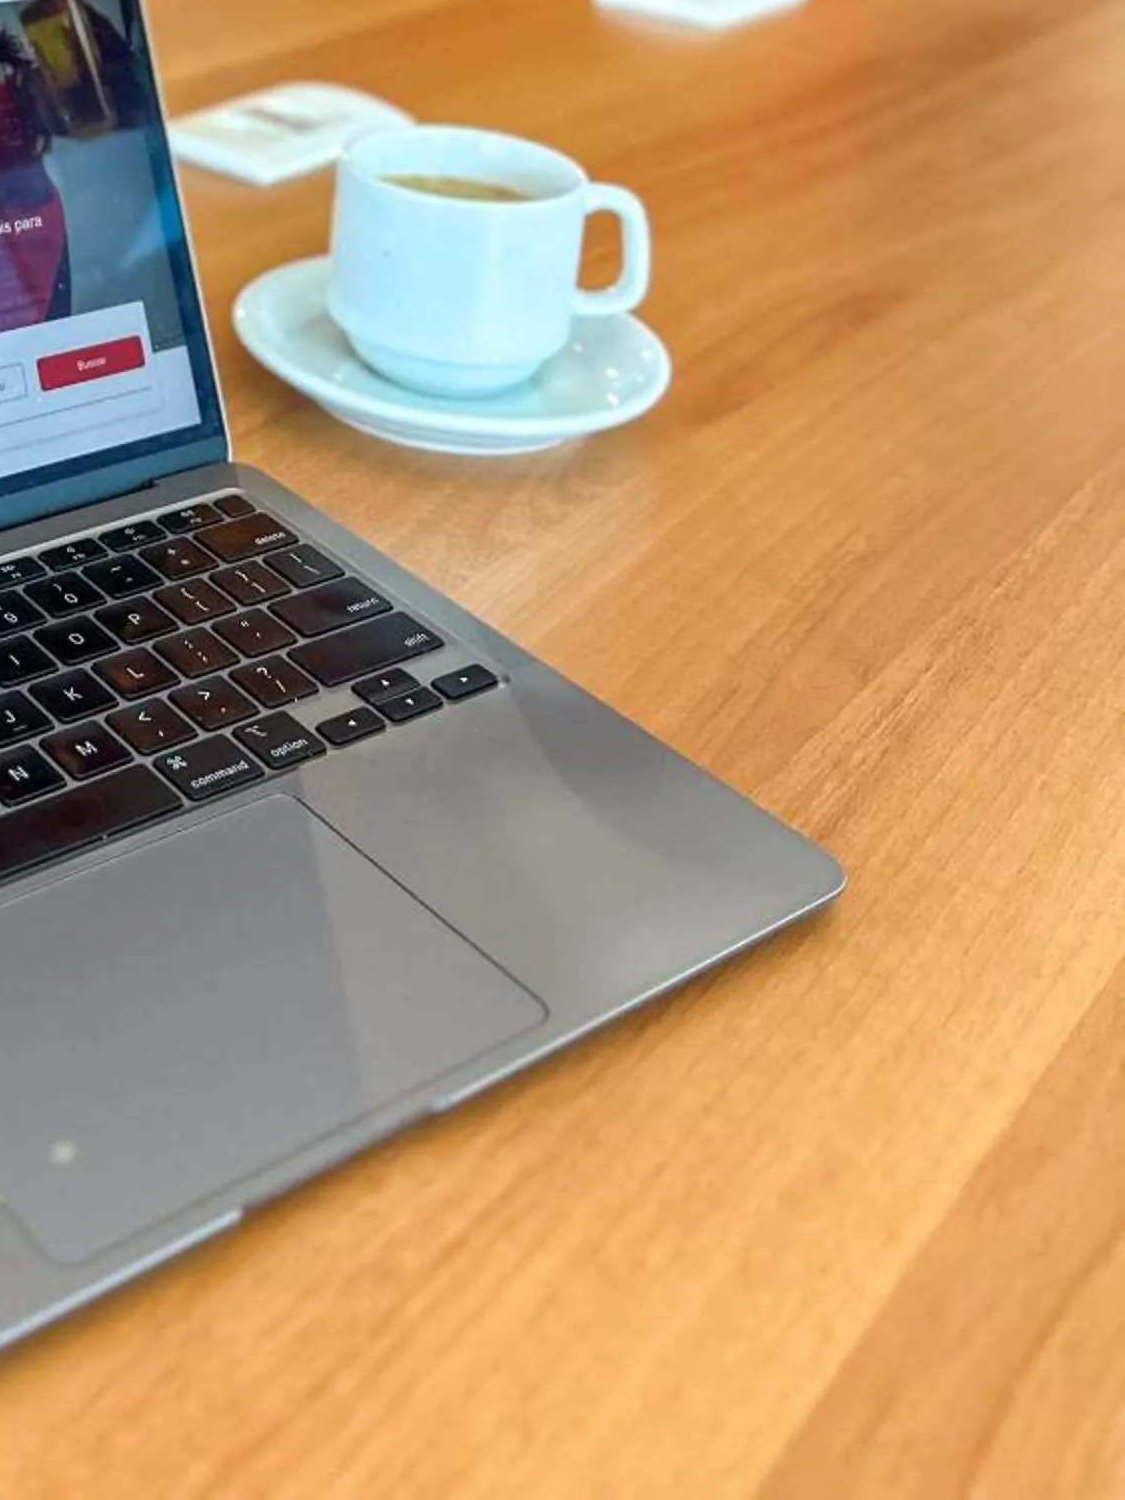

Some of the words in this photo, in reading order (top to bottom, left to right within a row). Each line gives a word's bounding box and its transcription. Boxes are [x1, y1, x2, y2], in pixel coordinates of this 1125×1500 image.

[14, 215, 43, 236] para
[64, 592, 79, 605] 0
[3, 611, 18, 624] 9
[127, 613, 141, 626] P
[69, 632, 85, 646] O
[9, 654, 21, 667] I
[126, 666, 144, 680] L
[63, 686, 83, 702] K
[5, 709, 17, 724] J
[75, 740, 98, 757] M
[271, 737, 308, 758] option
[8, 765, 30, 782] N
[190, 759, 251, 788] command
